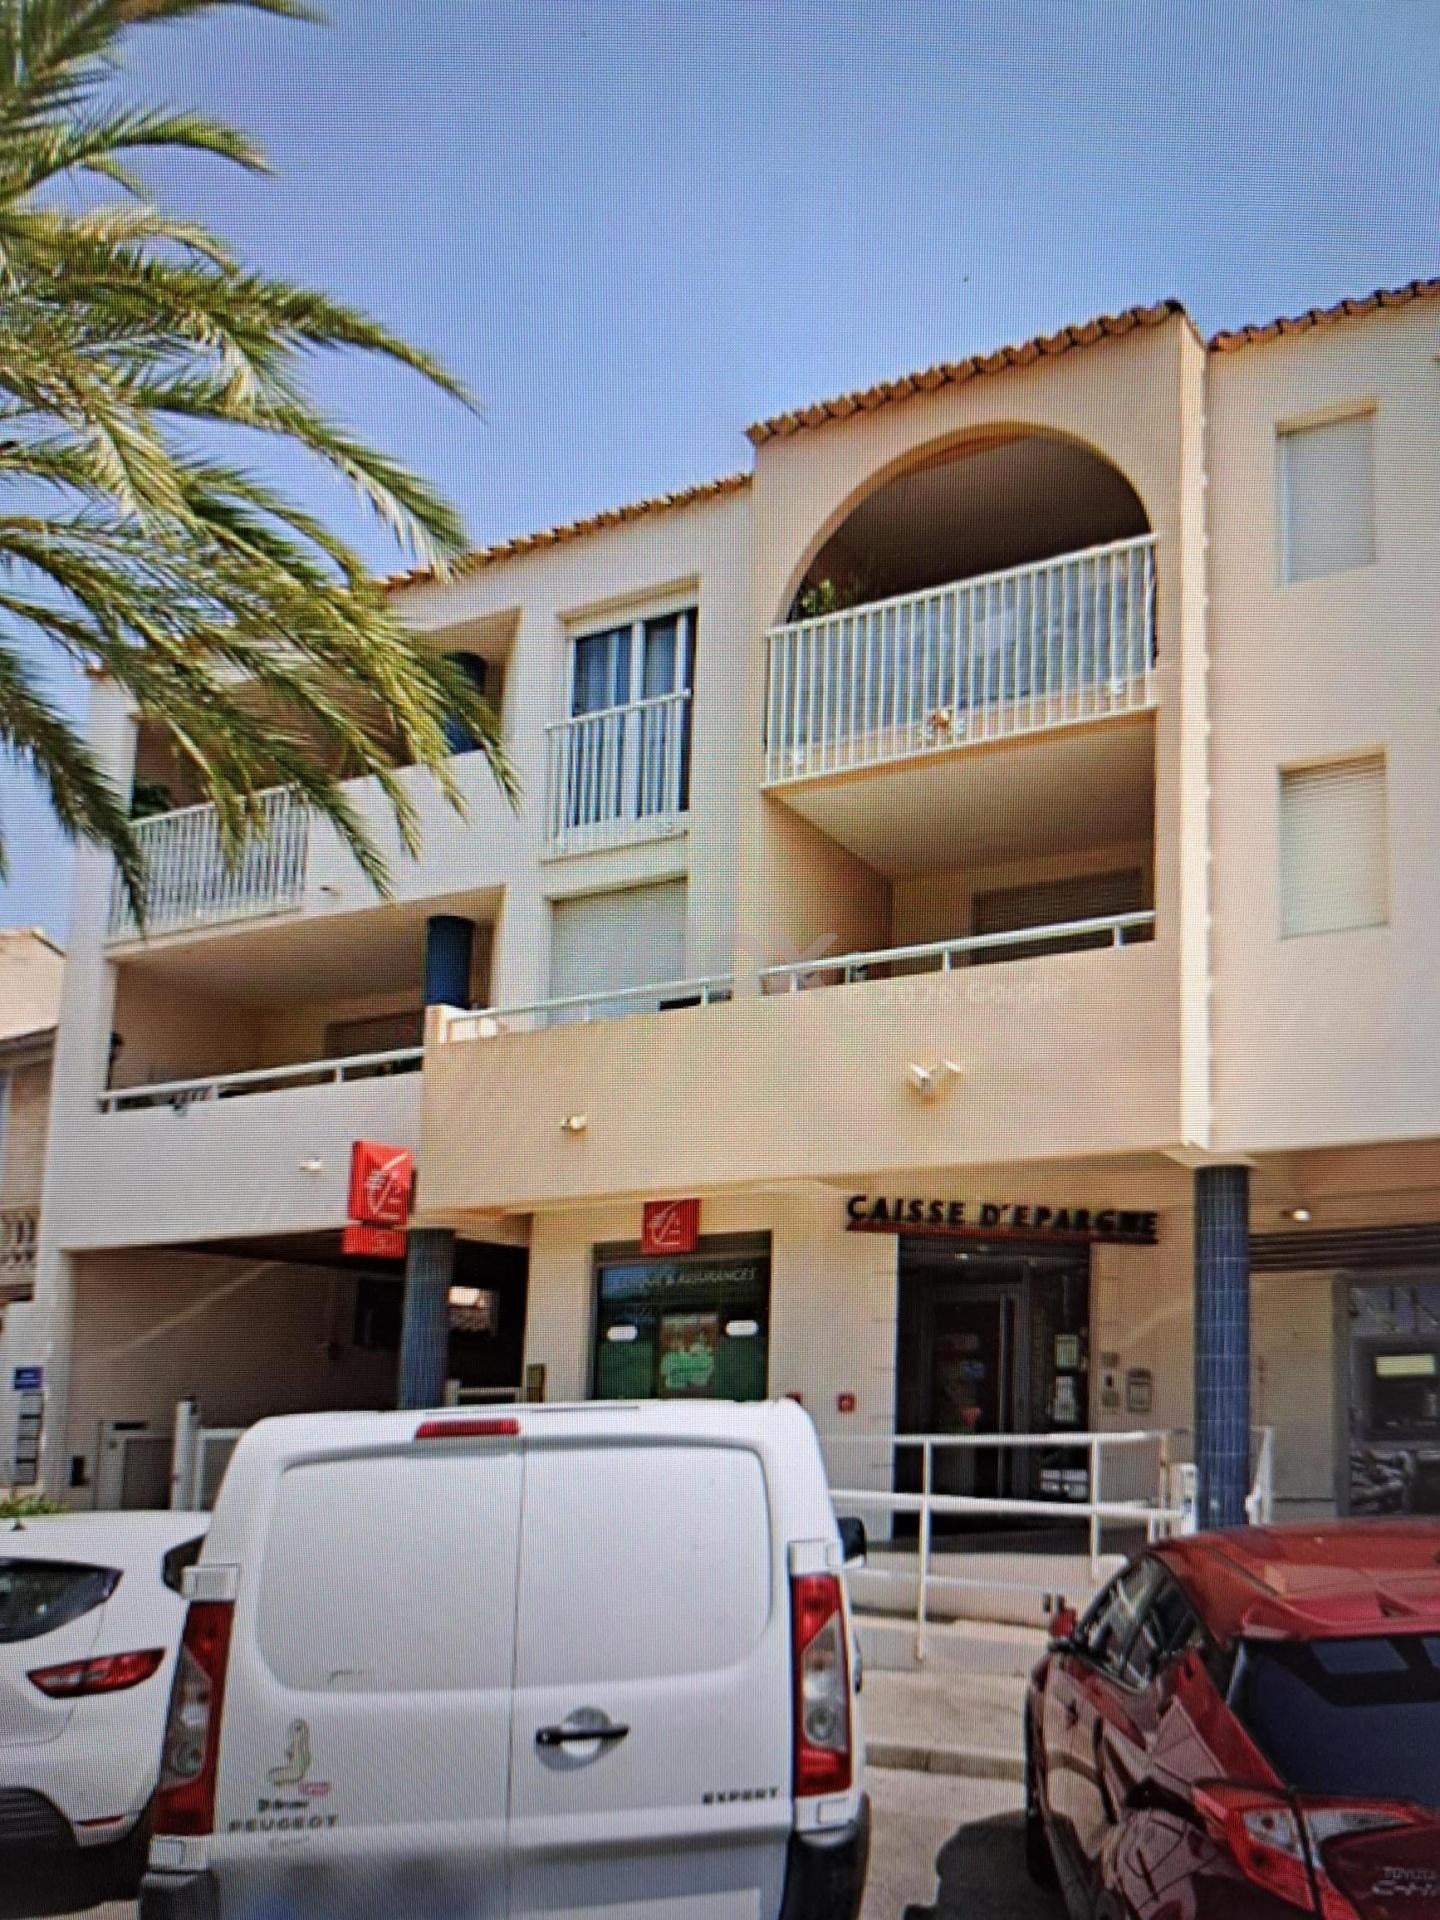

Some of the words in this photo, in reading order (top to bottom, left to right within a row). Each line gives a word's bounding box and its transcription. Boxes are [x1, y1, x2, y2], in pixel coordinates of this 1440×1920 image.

[847, 1195, 965, 1224] CAISSE
[979, 1202, 1159, 1234] D'EPARGNE
[702, 1785, 779, 1805] EXPERT
[229, 1815, 338, 1833] PEUGEOT
